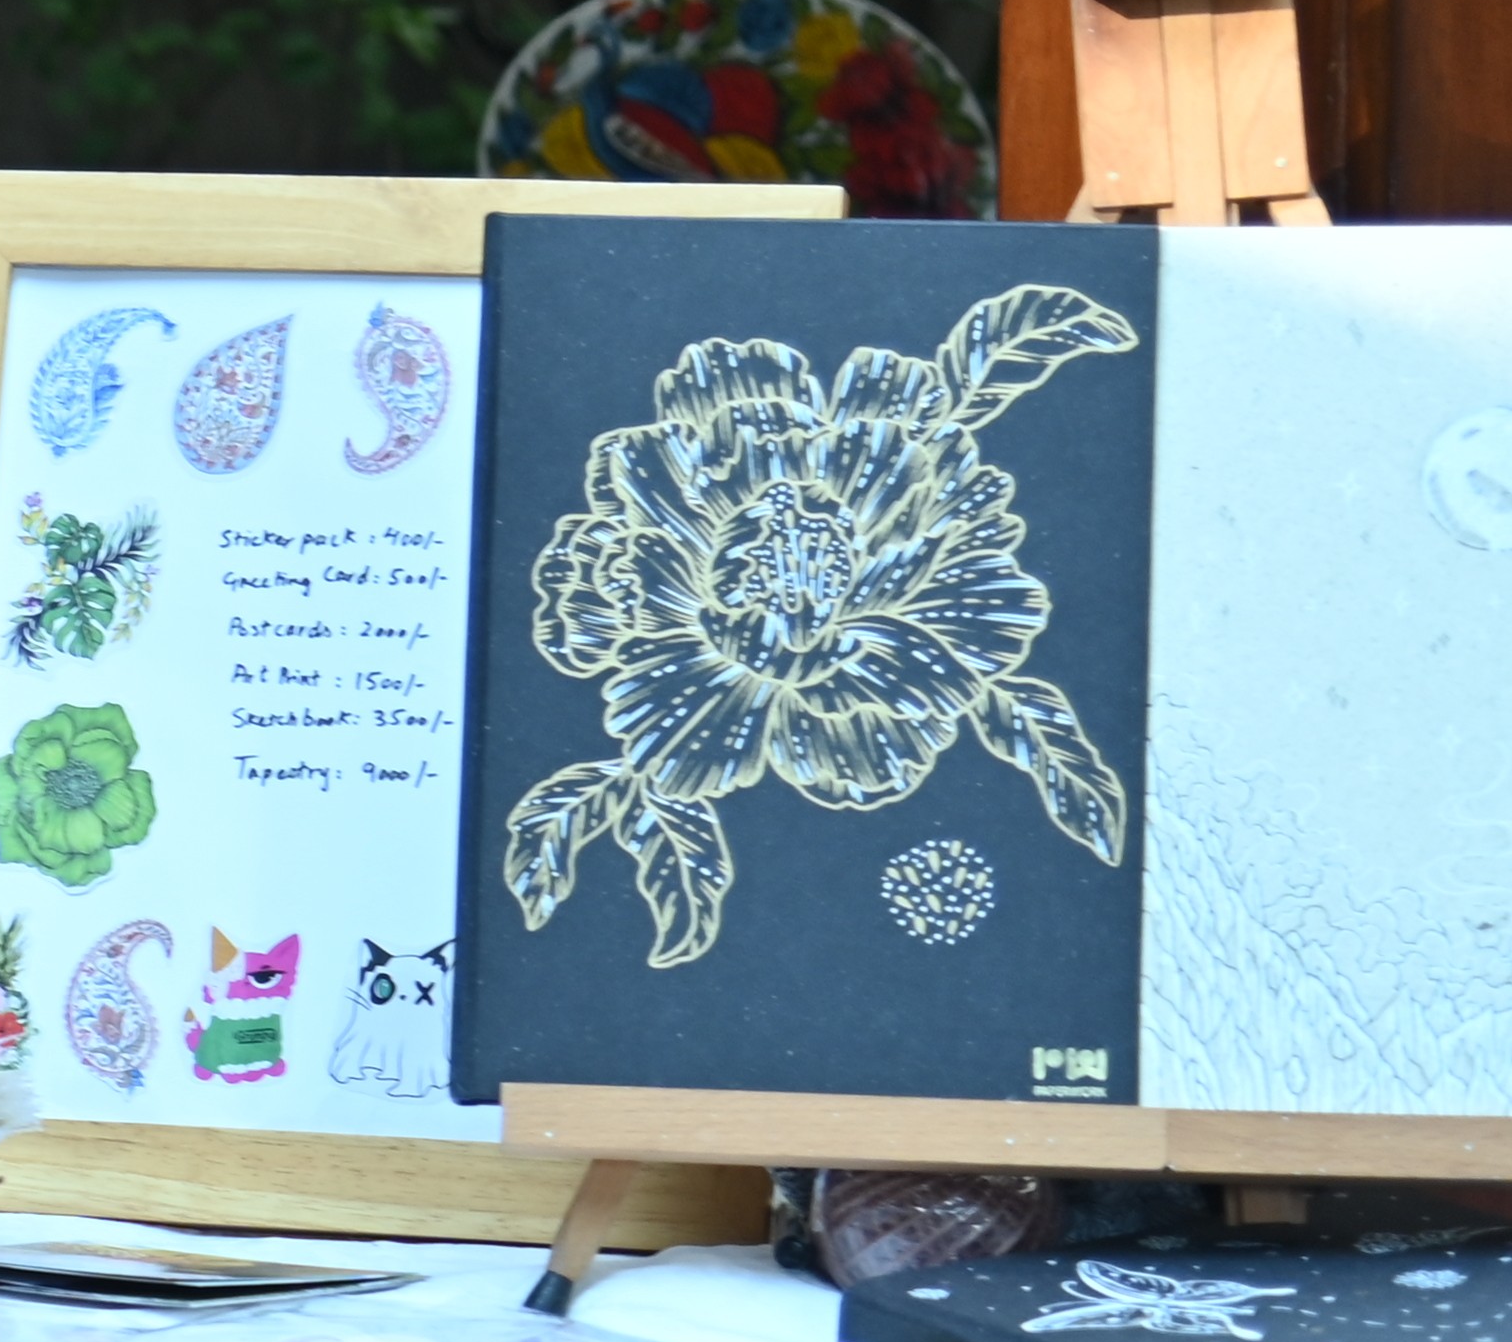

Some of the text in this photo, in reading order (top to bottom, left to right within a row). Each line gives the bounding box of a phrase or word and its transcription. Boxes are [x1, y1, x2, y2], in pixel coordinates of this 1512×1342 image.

[219, 529, 295, 548] Sticker
[299, 528, 356, 555] pack
[382, 527, 444, 550] 400/-
[222, 571, 312, 597] Greeting
[387, 567, 448, 590] 500/-
[359, 621, 430, 650] 2000/-
[231, 664, 269, 683] Art
[279, 667, 321, 686] Print
[355, 671, 425, 696] 1500/-
[373, 709, 454, 733] 3500/-
